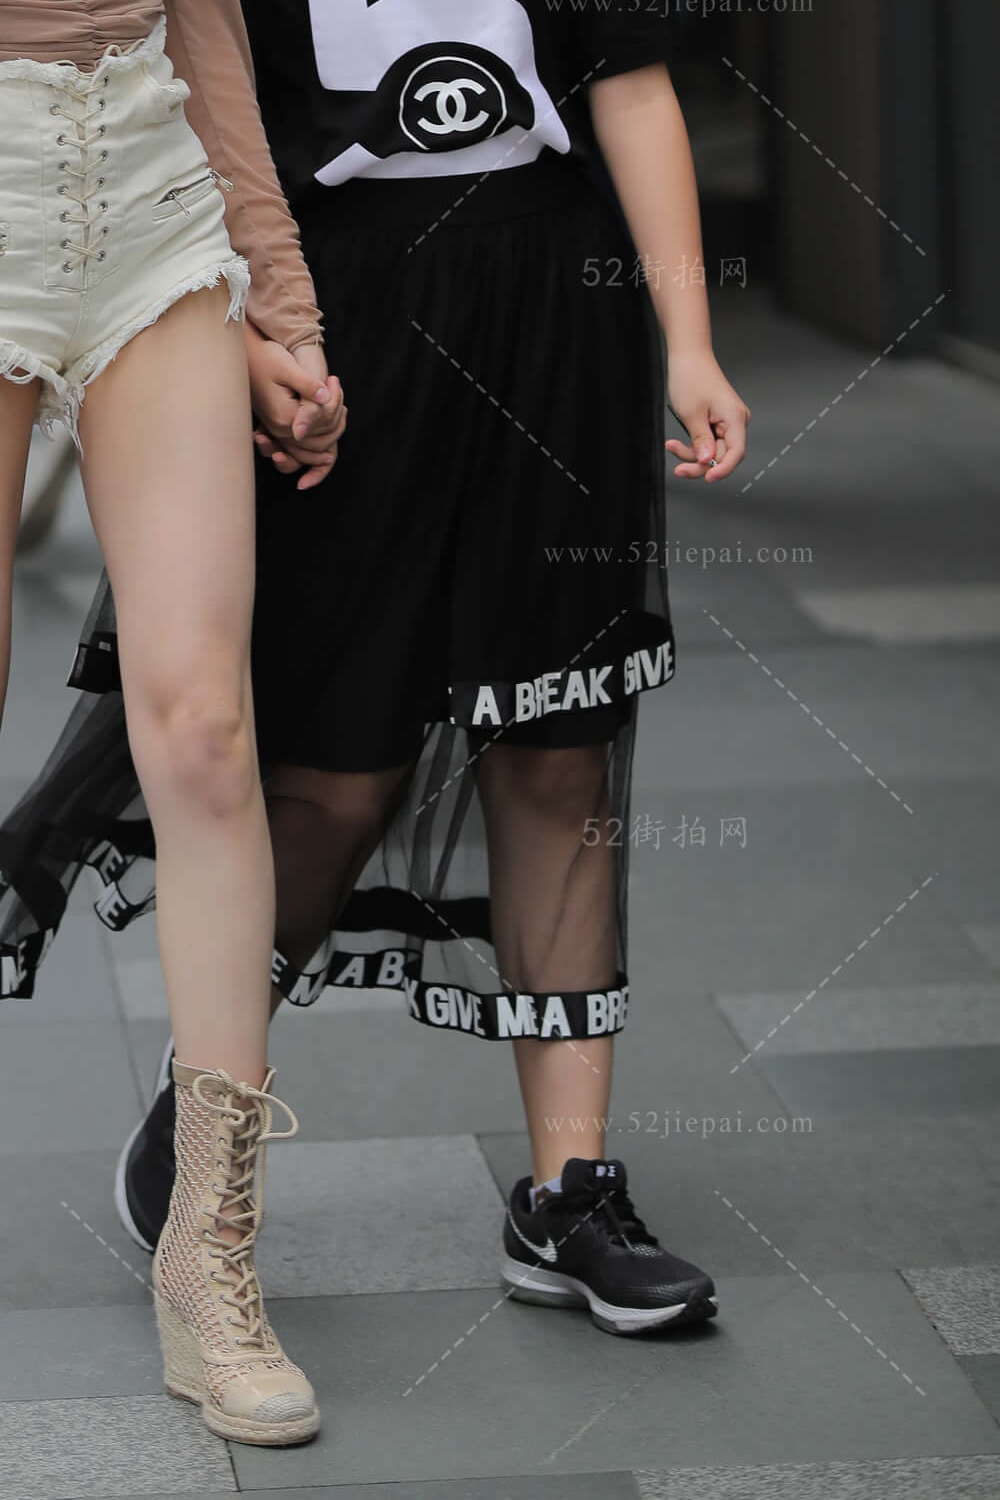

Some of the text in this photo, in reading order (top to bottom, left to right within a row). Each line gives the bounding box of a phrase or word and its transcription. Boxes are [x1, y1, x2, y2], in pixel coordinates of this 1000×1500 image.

[472, 686, 502, 725] A
[624, 641, 675, 696] GIVE
[425, 987, 486, 1036] GIVE
[541, 996, 572, 1038] A
